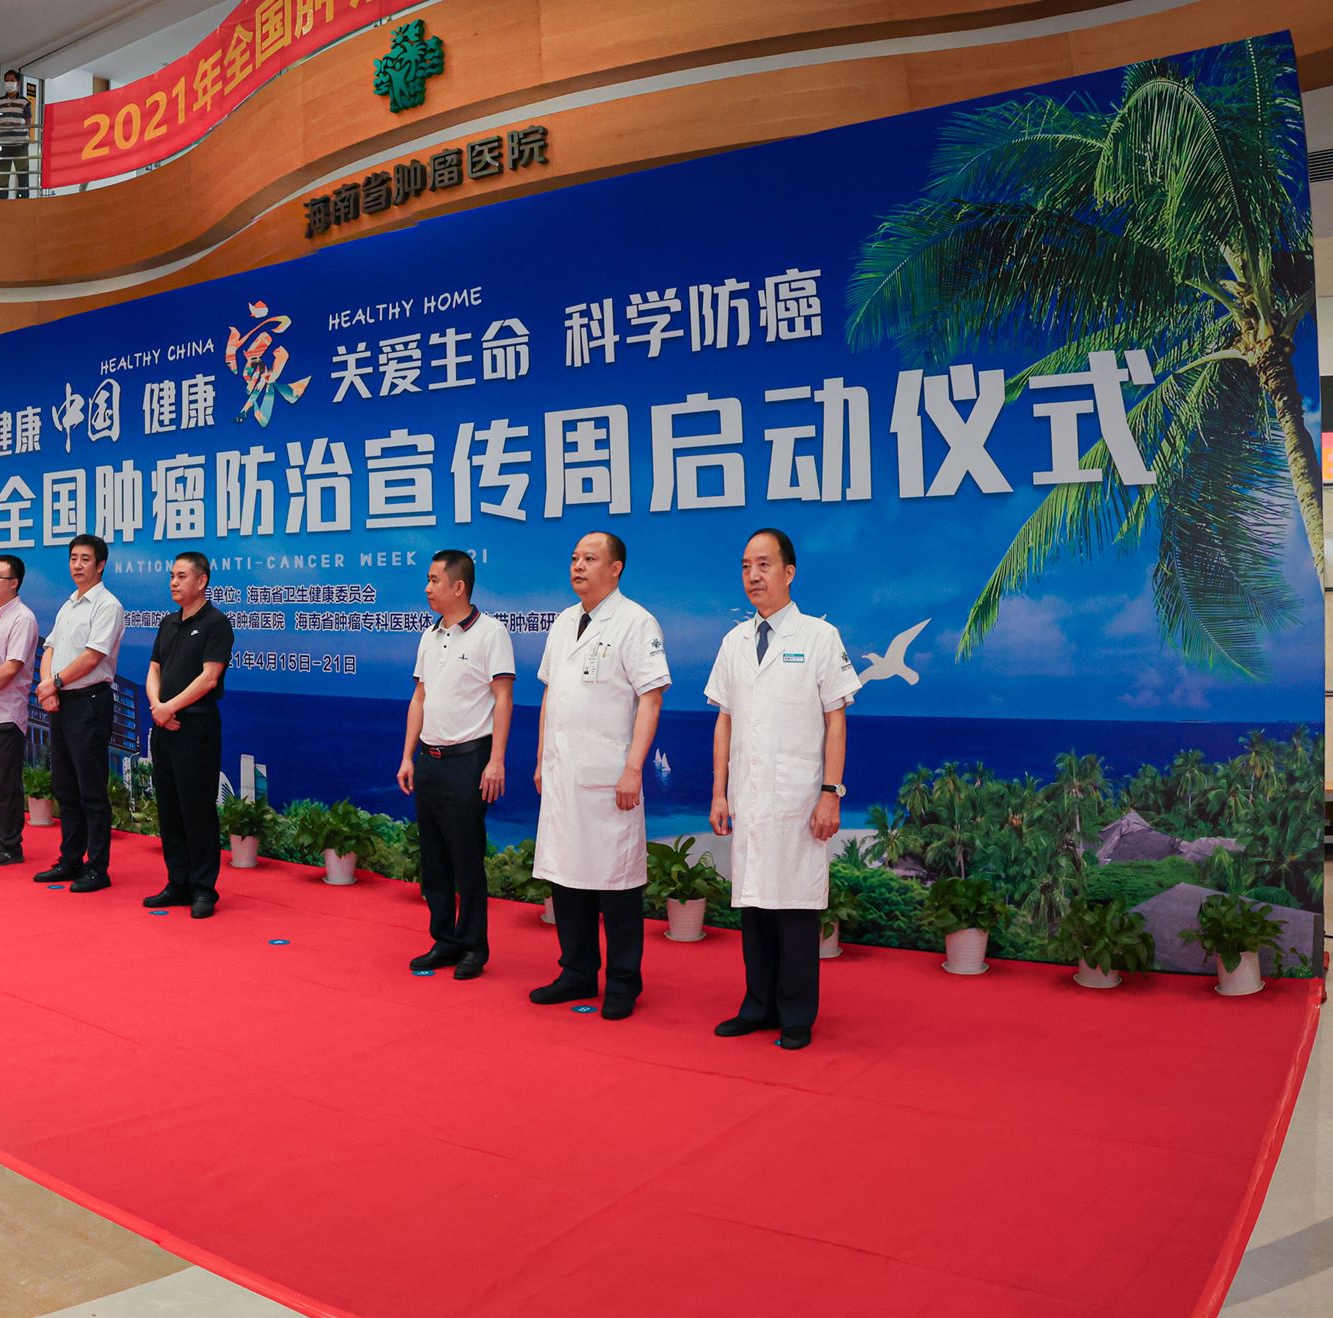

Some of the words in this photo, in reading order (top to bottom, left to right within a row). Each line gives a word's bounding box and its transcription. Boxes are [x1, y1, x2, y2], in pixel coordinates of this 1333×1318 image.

[81, 0, 373, 160] 2021年全国
[304, 125, 549, 239] 海南省肿瘤医院
[324, 299, 414, 331] HEALTHY
[424, 286, 482, 315] HOME
[51, 378, 121, 453] 中国
[142, 373, 216, 435] 健康
[330, 317, 531, 403] 关爱生命
[564, 268, 822, 368] 科学防癌
[100, 348, 161, 375] HEALTHY
[167, 338, 214, 361] CHINA
[115, 559, 173, 573] NATION
[360, 551, 417, 567] WEEK
[247, 584, 376, 604] 海南省卫生健康委员会
[295, 611, 433, 632] 海南省肿瘤专科医联体
